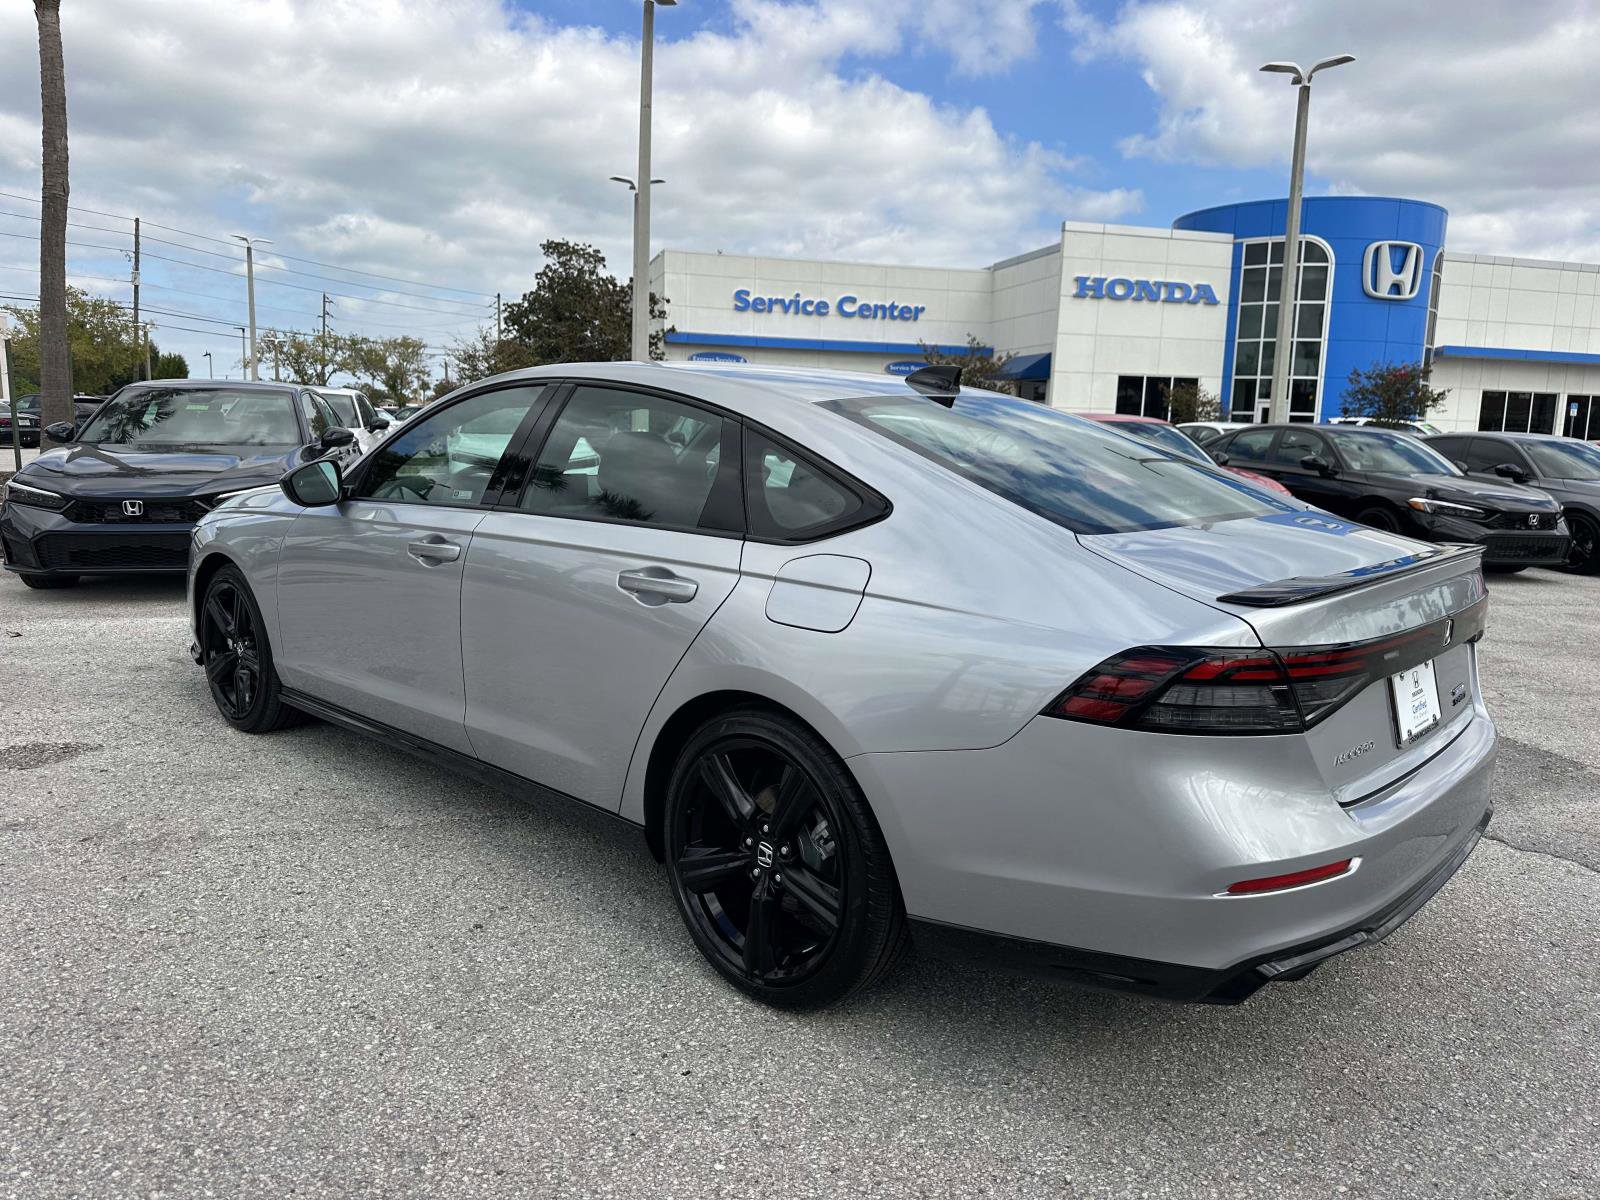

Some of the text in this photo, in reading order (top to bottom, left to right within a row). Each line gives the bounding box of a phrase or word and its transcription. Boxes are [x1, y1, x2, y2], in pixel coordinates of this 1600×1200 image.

[734, 289, 925, 321] Service Center
[1073, 276, 1220, 305] HONDA
